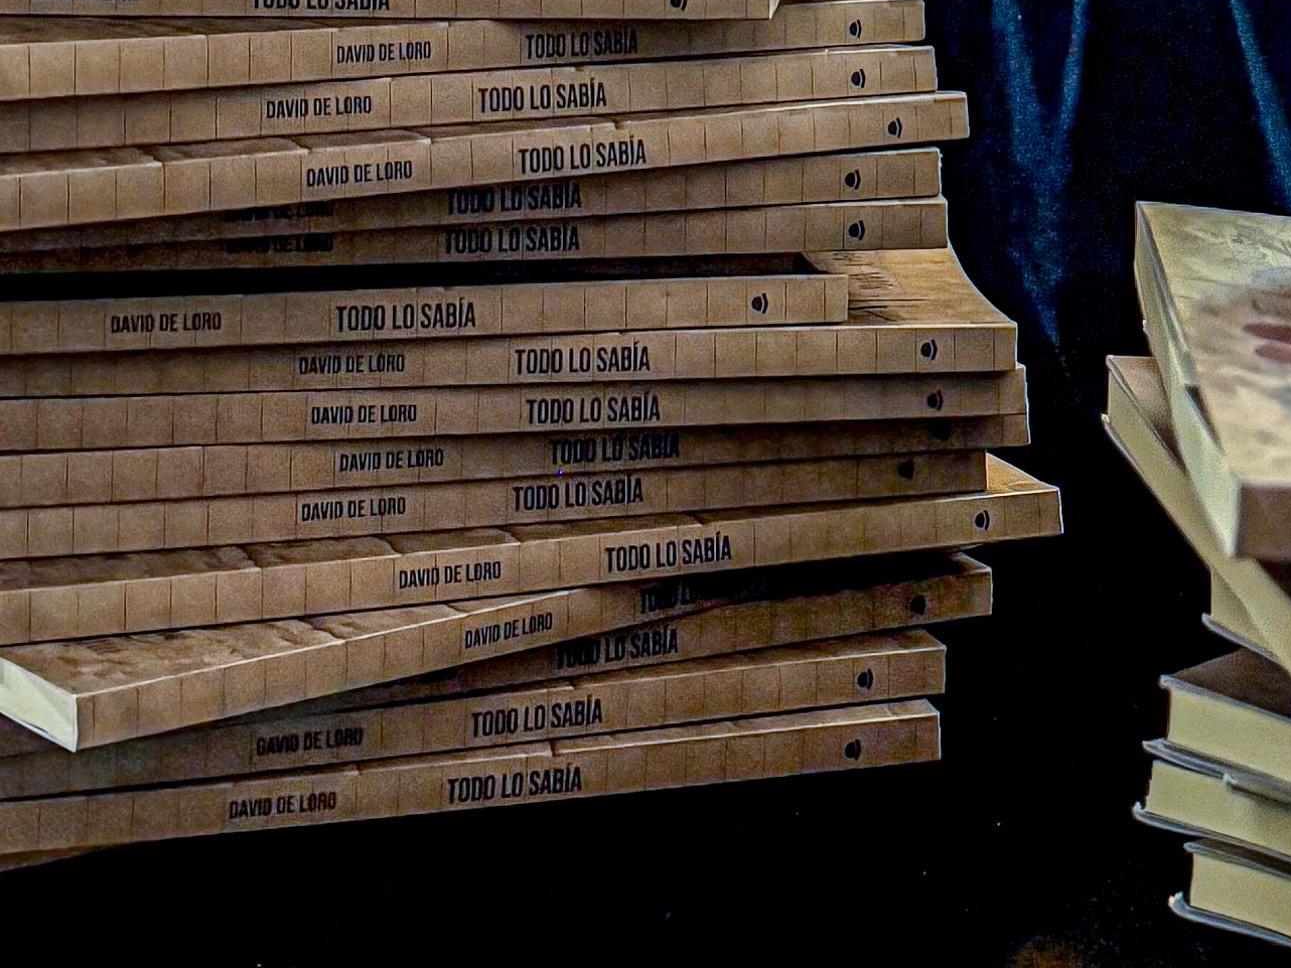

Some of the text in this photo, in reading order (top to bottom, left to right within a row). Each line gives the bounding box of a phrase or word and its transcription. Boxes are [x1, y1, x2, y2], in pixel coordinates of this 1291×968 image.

[337, 41, 431, 64] DAVID DE LORO
[526, 27, 638, 58] TODO LO SABÍA
[266, 95, 371, 118] DAVID DE LORO
[479, 78, 606, 112] TODO LO SABÍA
[518, 139, 646, 173] TODO LO SABÍA
[307, 161, 412, 187] DAVID DE LORO
[111, 311, 222, 333] DAVID DE LORO
[336, 297, 476, 331] TODO LO SABÍA
[515, 341, 650, 374] TODO LO SABÍA
[311, 402, 417, 423] DAVID DE LORO
[526, 392, 660, 424] TODO LO SABÍA
[340, 448, 443, 472] DAVID DE LORO
[512, 474, 642, 511] TODO LO SABÍA
[605, 533, 731, 572] TODO LO SABÍA
[400, 562, 500, 589] DAVID DE LORO
[465, 612, 553, 649] DAVID DE LORO
[472, 700, 602, 736] TODO LO SABÍA
[448, 769, 582, 803] TODO LO SABÍA
[230, 791, 336, 820] DAVID DE LORO
